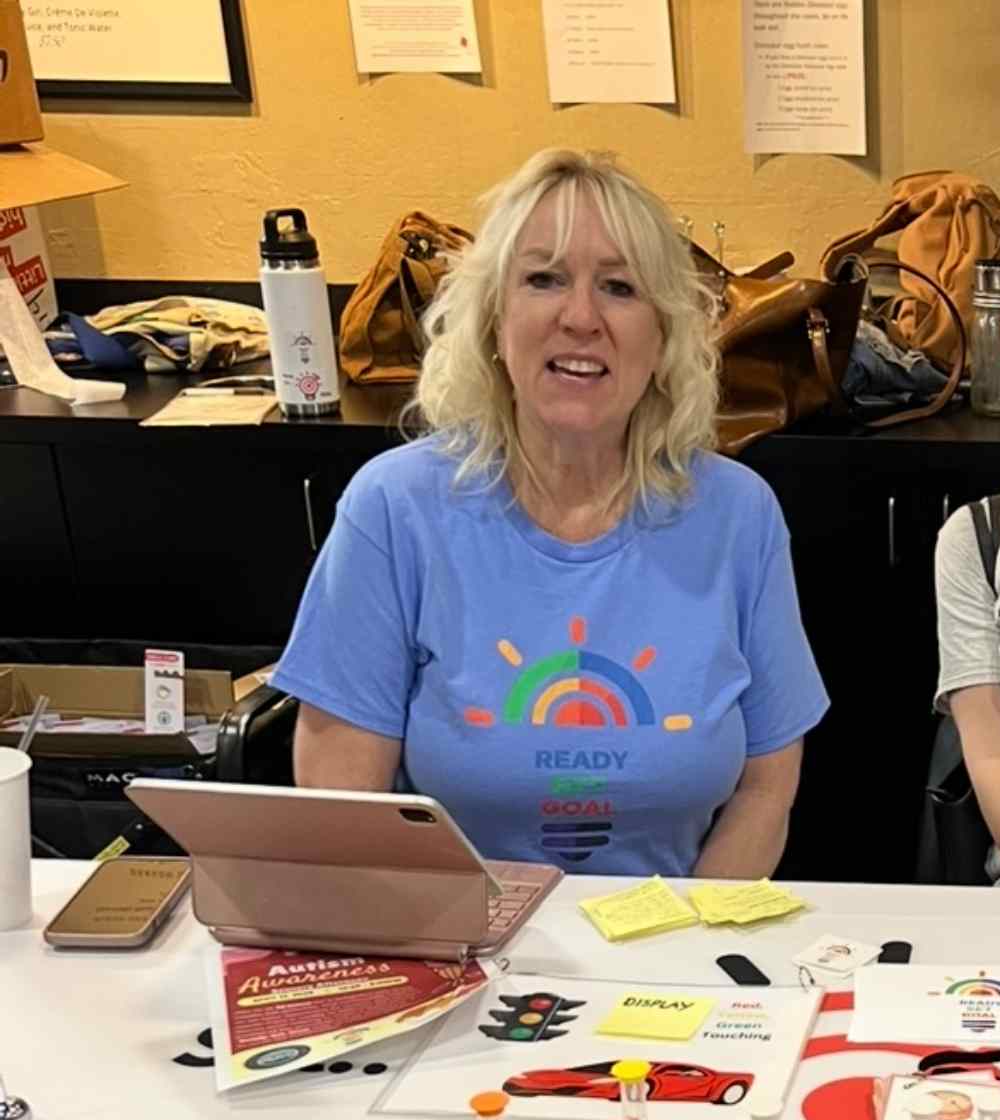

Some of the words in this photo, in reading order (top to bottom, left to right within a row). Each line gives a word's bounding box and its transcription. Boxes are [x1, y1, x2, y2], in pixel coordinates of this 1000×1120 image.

[535, 751, 629, 770] READY
[541, 800, 614, 816] GOAL
[268, 957, 366, 977] Autism
[237, 962, 391, 996] Awareness
[623, 997, 695, 1012] DISPLAY
